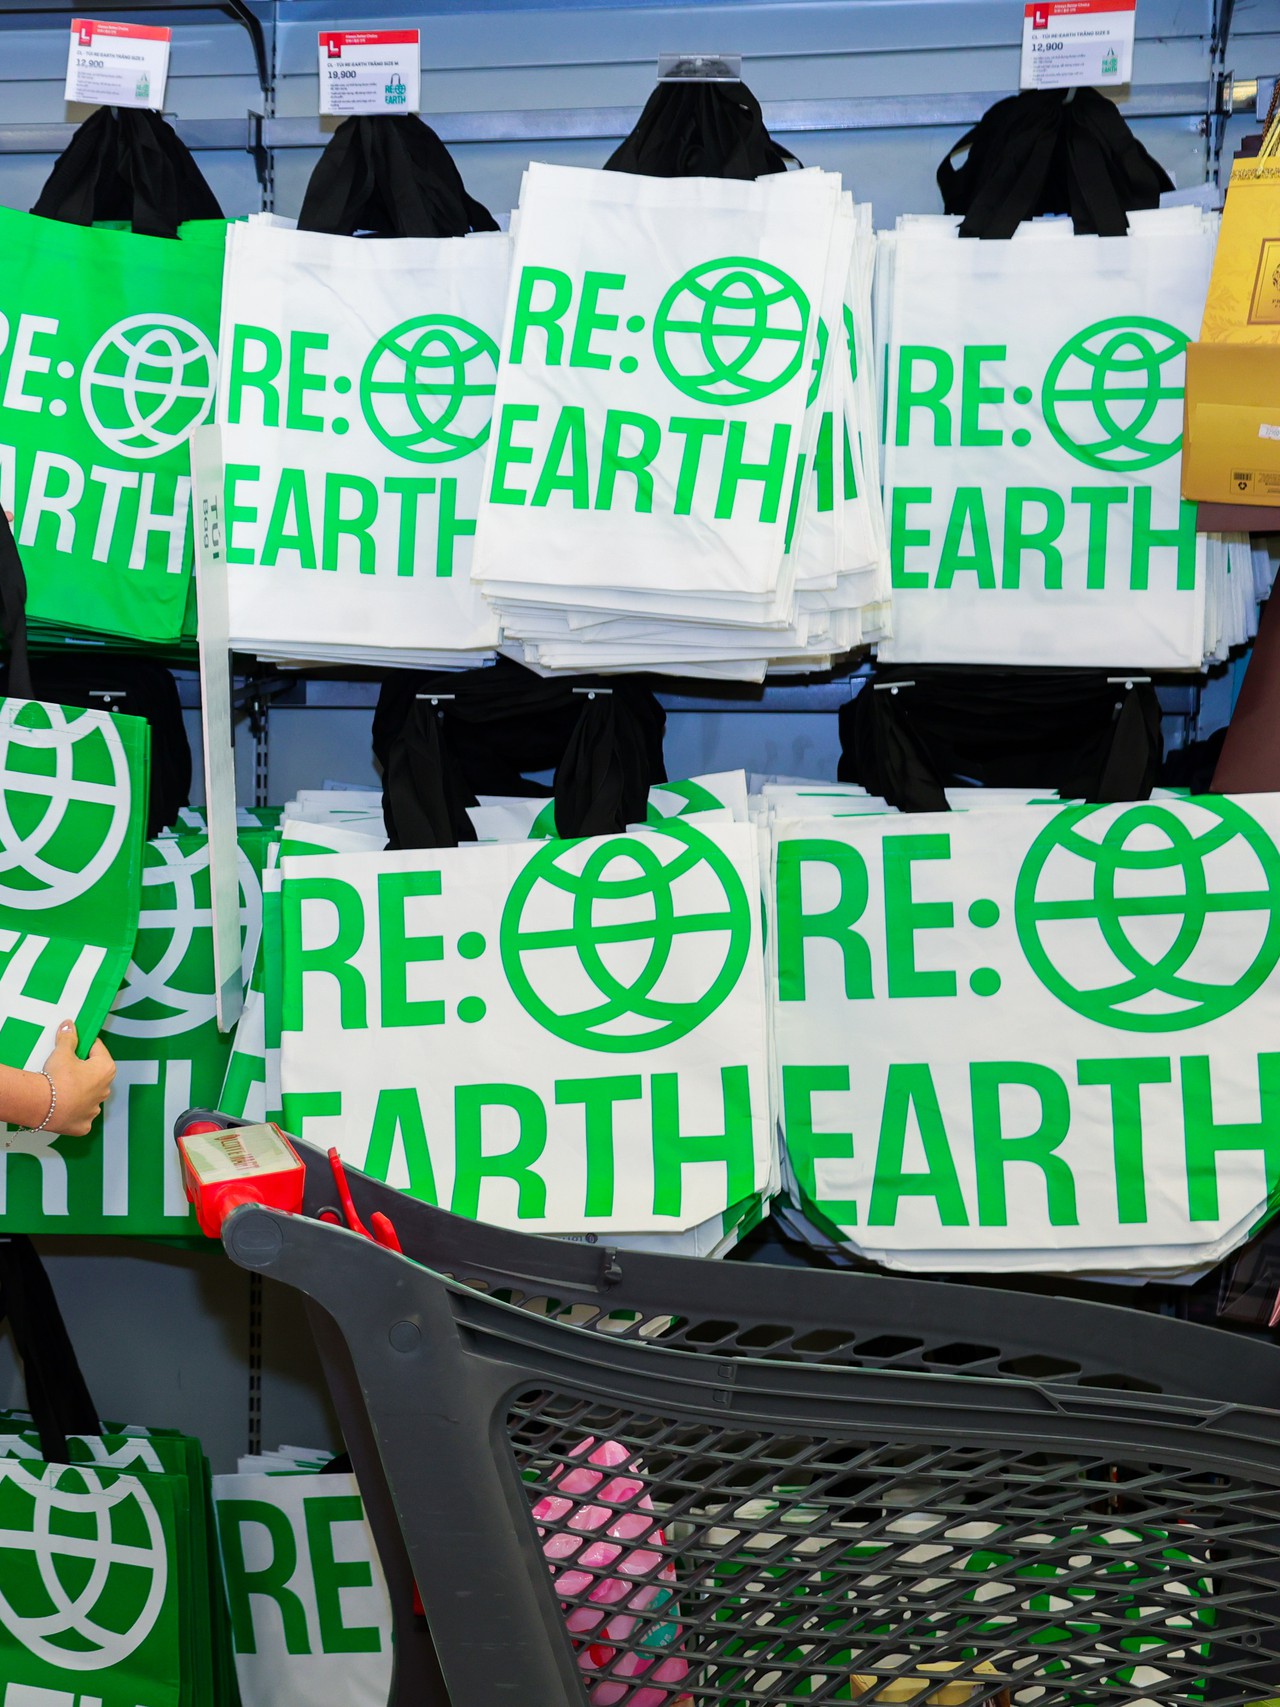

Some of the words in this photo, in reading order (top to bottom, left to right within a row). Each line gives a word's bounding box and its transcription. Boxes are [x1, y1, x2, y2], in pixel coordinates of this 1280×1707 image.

[76, 59, 104, 68] 12,900
[328, 71, 356, 79] 19,900
[1032, 42, 1063, 52] 12,900
[510, 266, 644, 373] RE:
[228, 323, 351, 435] RE:
[895, 345, 1032, 446] RE:
[489, 405, 792, 523] EARTH
[891, 486, 1197, 590] EARTH
[283, 871, 489, 1030] RE:
[778, 834, 1002, 1000] RE:
[784, 1056, 1280, 1228] EARTH
